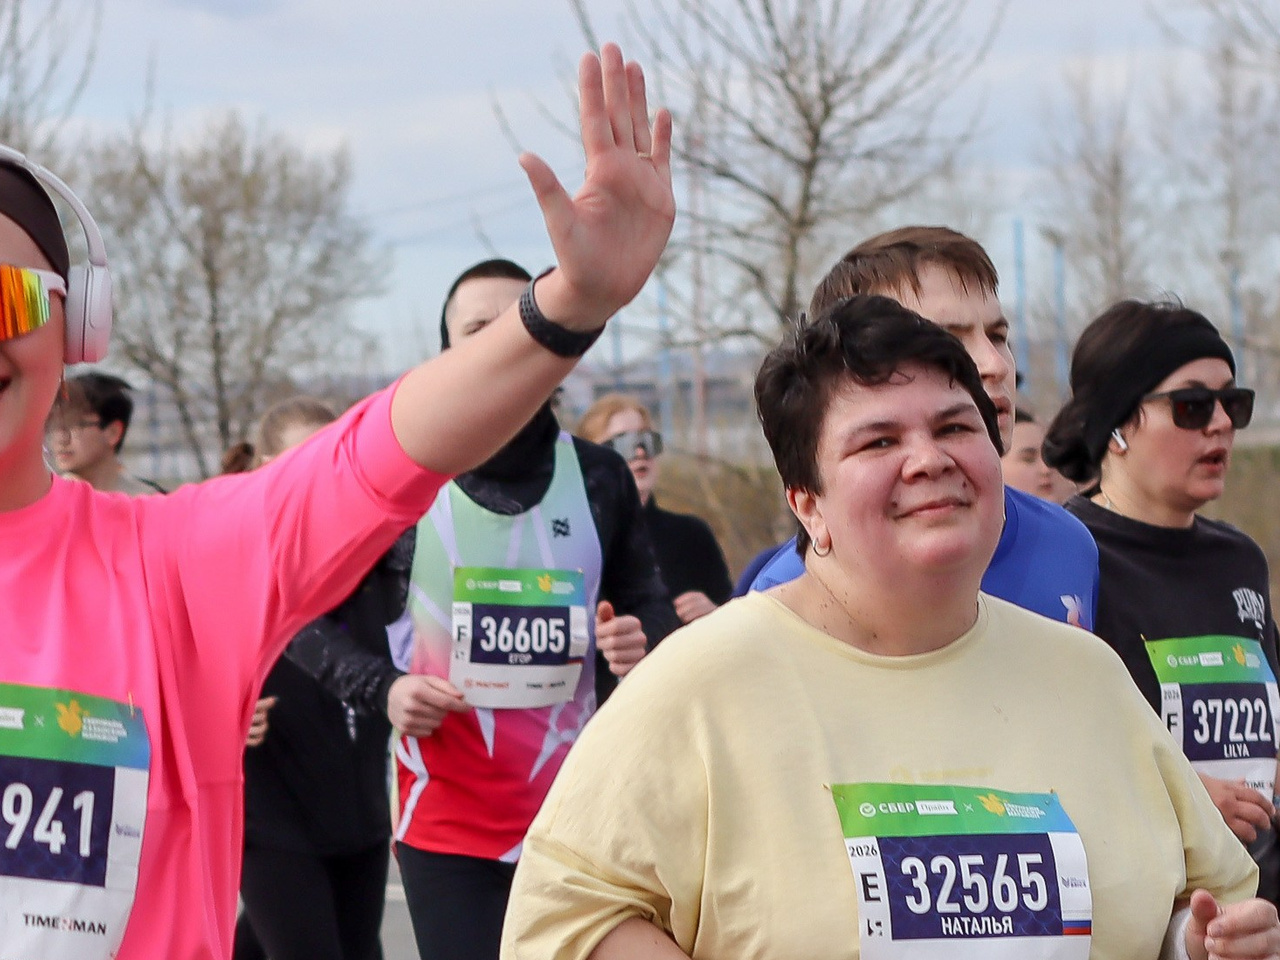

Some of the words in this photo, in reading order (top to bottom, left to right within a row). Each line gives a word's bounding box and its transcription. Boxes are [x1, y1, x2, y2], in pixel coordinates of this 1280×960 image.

[480, 616, 565, 653] 36605
[1193, 698, 1272, 744] 37222
[1223, 743, 1250, 758] LILYA
[879, 802, 915, 814] СБЕР
[849, 844, 878, 857] 2026
[861, 872, 881, 902] E
[901, 853, 1048, 914] 32565
[941, 916, 1014, 935] НАТАЛЬЯ
